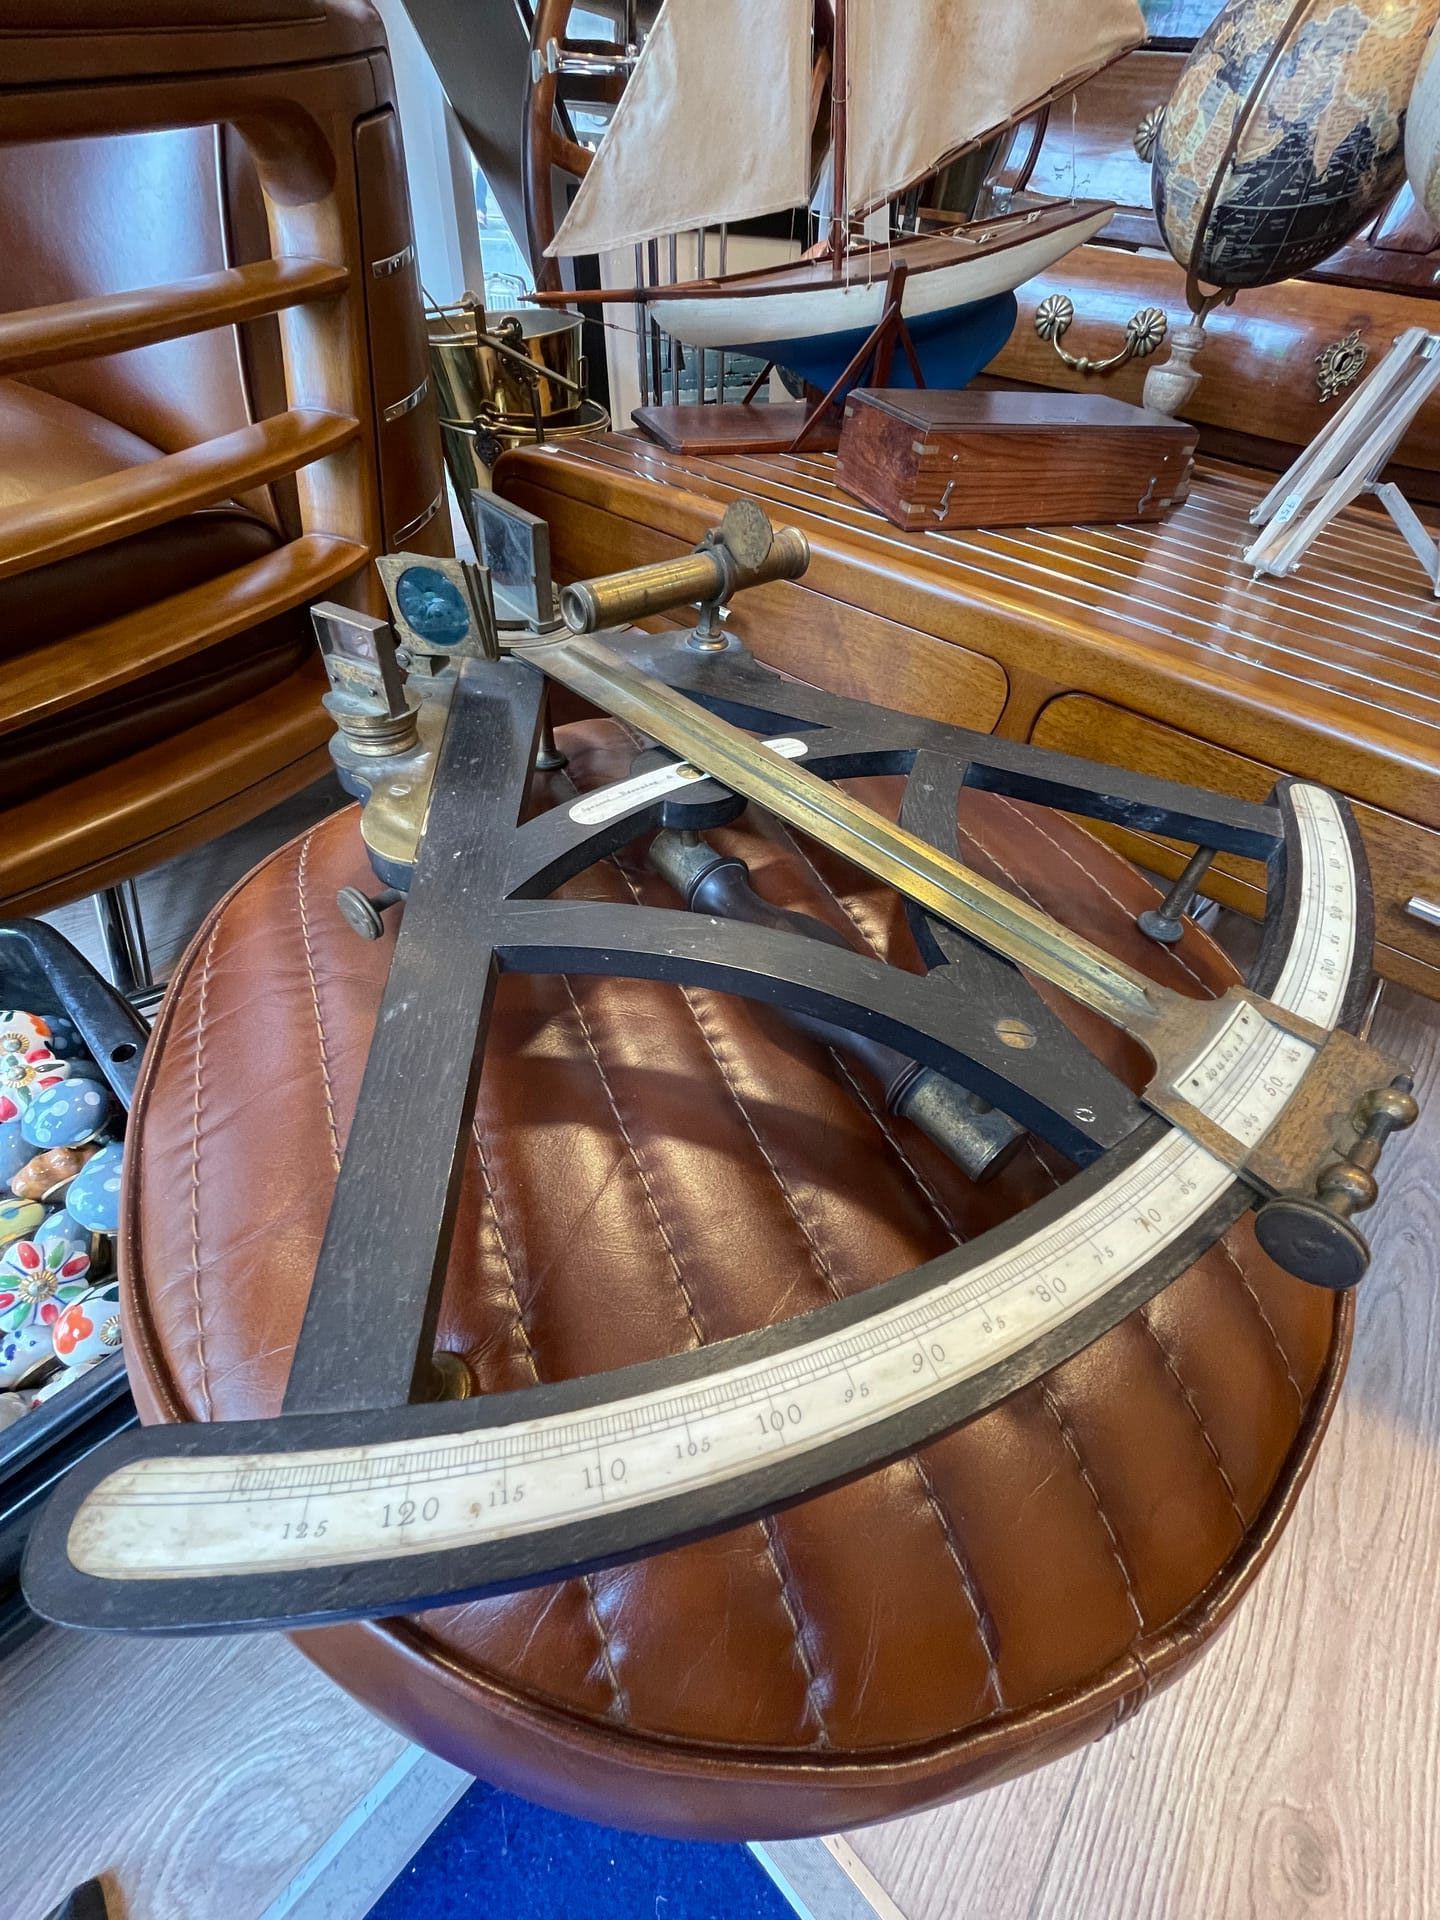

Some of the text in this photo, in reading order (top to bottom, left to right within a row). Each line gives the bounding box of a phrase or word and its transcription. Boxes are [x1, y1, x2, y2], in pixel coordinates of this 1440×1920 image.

[1263, 1075, 1284, 1097] 50
[280, 1178, 1197, 1541] 125 120 115 110 105 100 95 90 85 80 75 70 65
